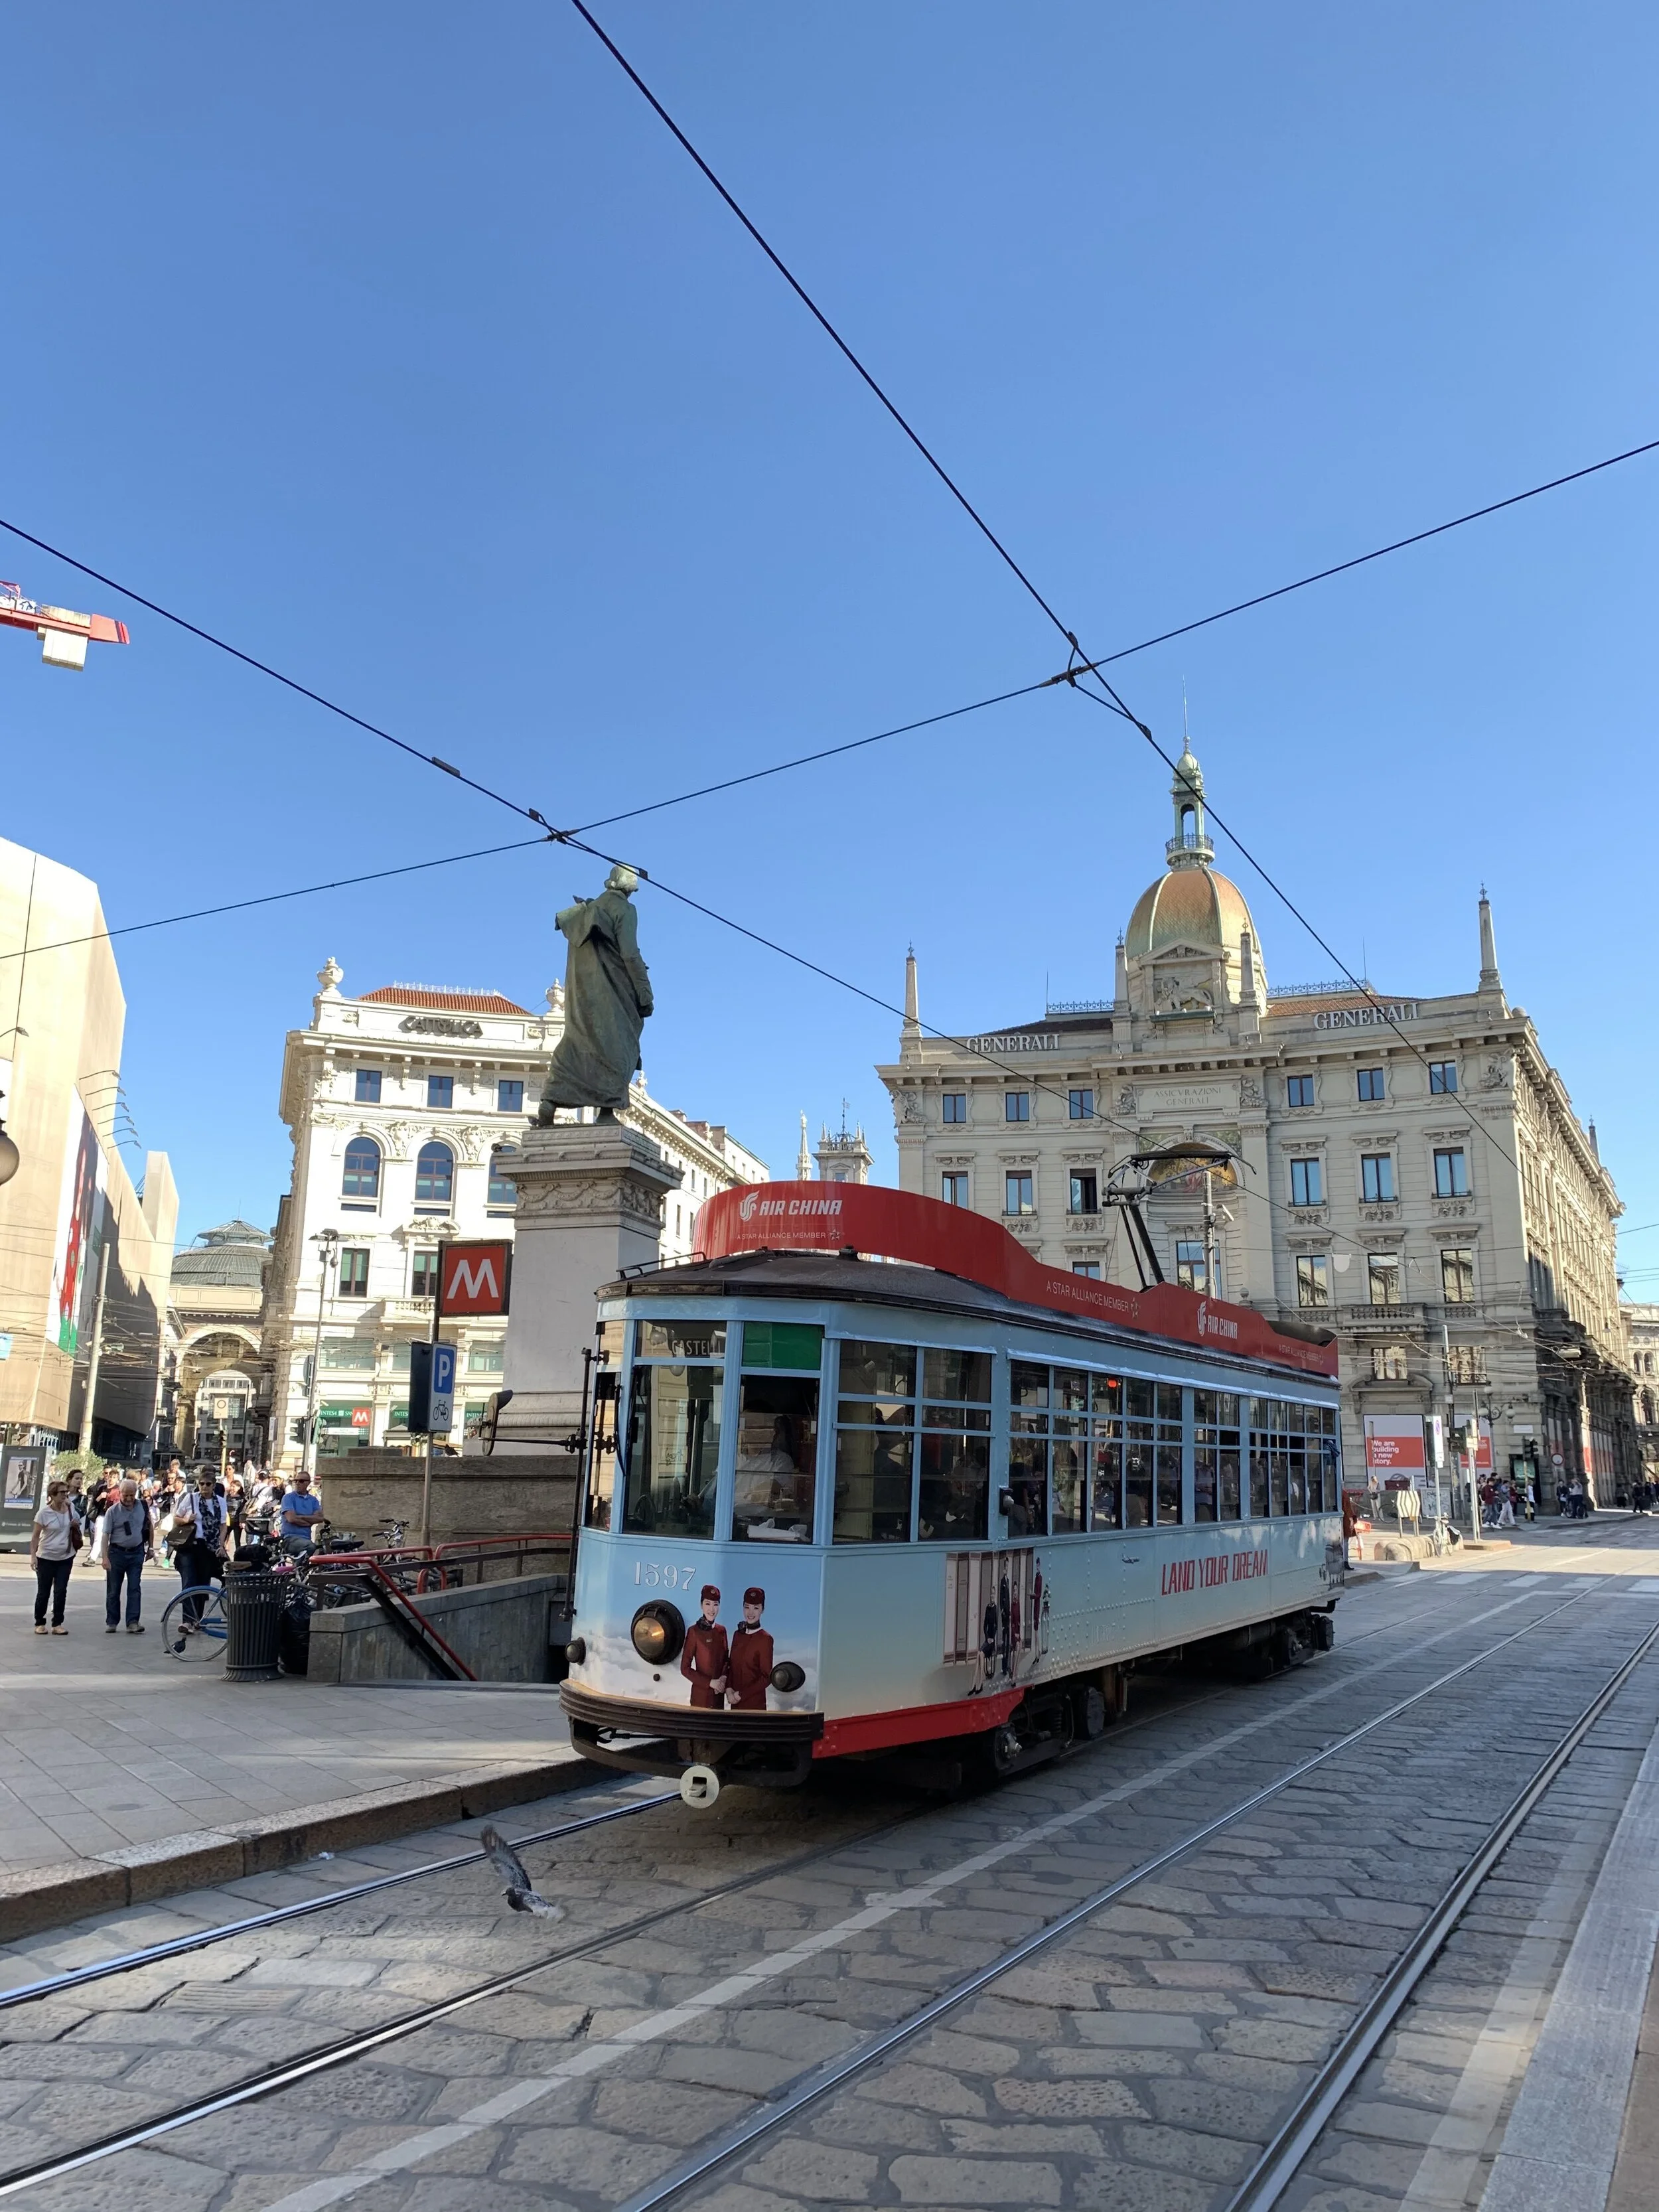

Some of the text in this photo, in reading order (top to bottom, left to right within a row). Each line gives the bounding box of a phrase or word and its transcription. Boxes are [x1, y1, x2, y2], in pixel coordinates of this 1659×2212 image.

[400, 1015, 484, 1039] CATTOLICA
[1313, 1002, 1419, 1030] GENERALI
[966, 1033, 1060, 1054] GENERALI
[758, 1199, 843, 1216] AIR CHINA
[447, 1258, 499, 1299] M
[1046, 1280, 1129, 1313] A STAR ALLIANCE MEMBER
[1207, 1315, 1238, 1339] AIR CHINA
[437, 1353, 451, 1388] P
[354, 1412, 368, 1423] M
[634, 1560, 696, 1591] 1597
[1161, 1549, 1268, 1596] LAND YOUR DREAM
